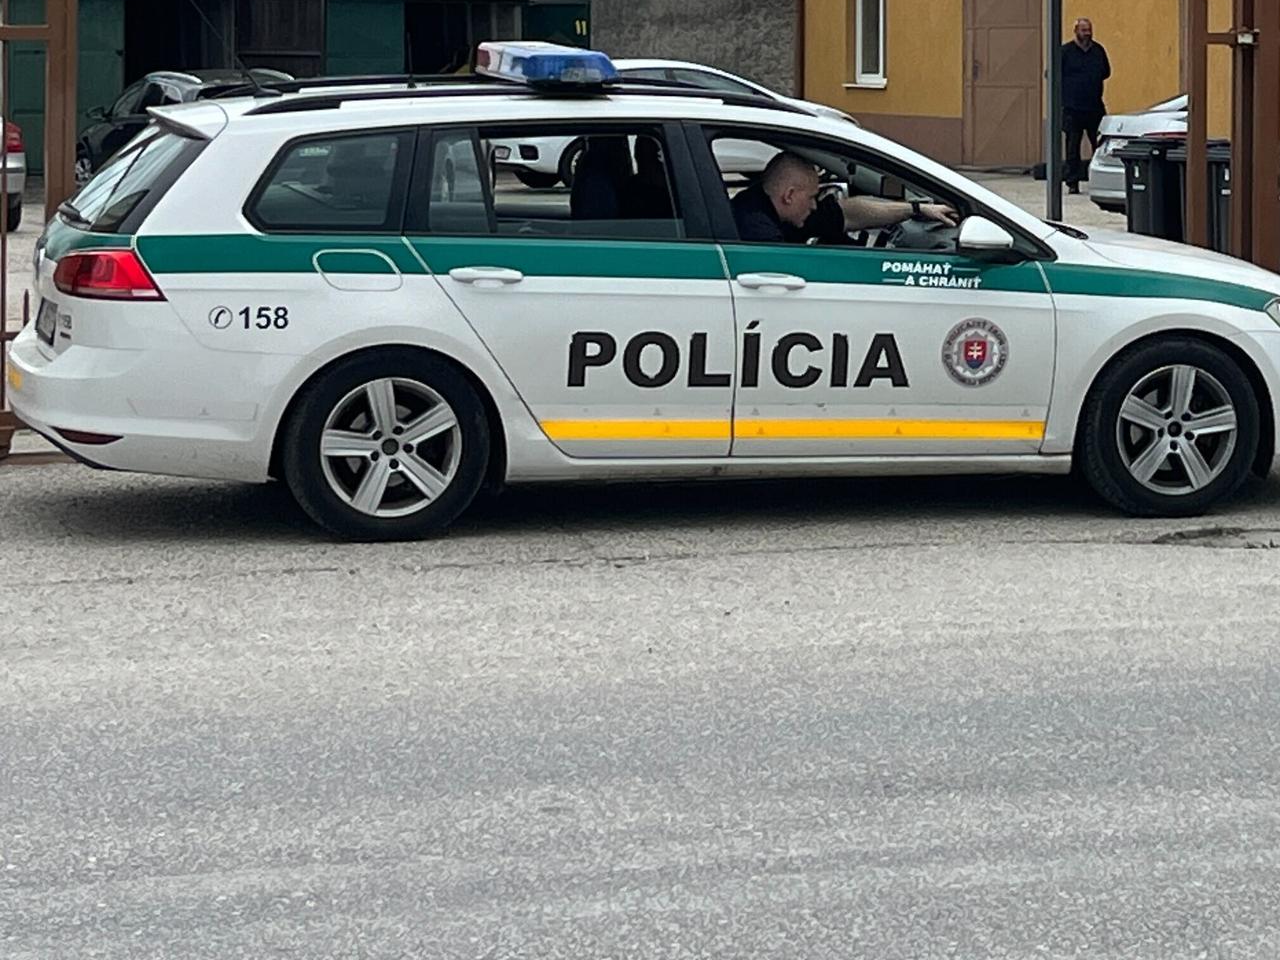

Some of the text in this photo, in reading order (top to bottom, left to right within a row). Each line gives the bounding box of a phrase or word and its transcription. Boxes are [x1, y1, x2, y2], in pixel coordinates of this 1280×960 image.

[882, 261, 952, 275] POMÁHAŤ
[905, 275, 982, 289] A CHRÁNIŤ
[238, 306, 289, 330] 158
[566, 320, 910, 388] POLÍCIA
